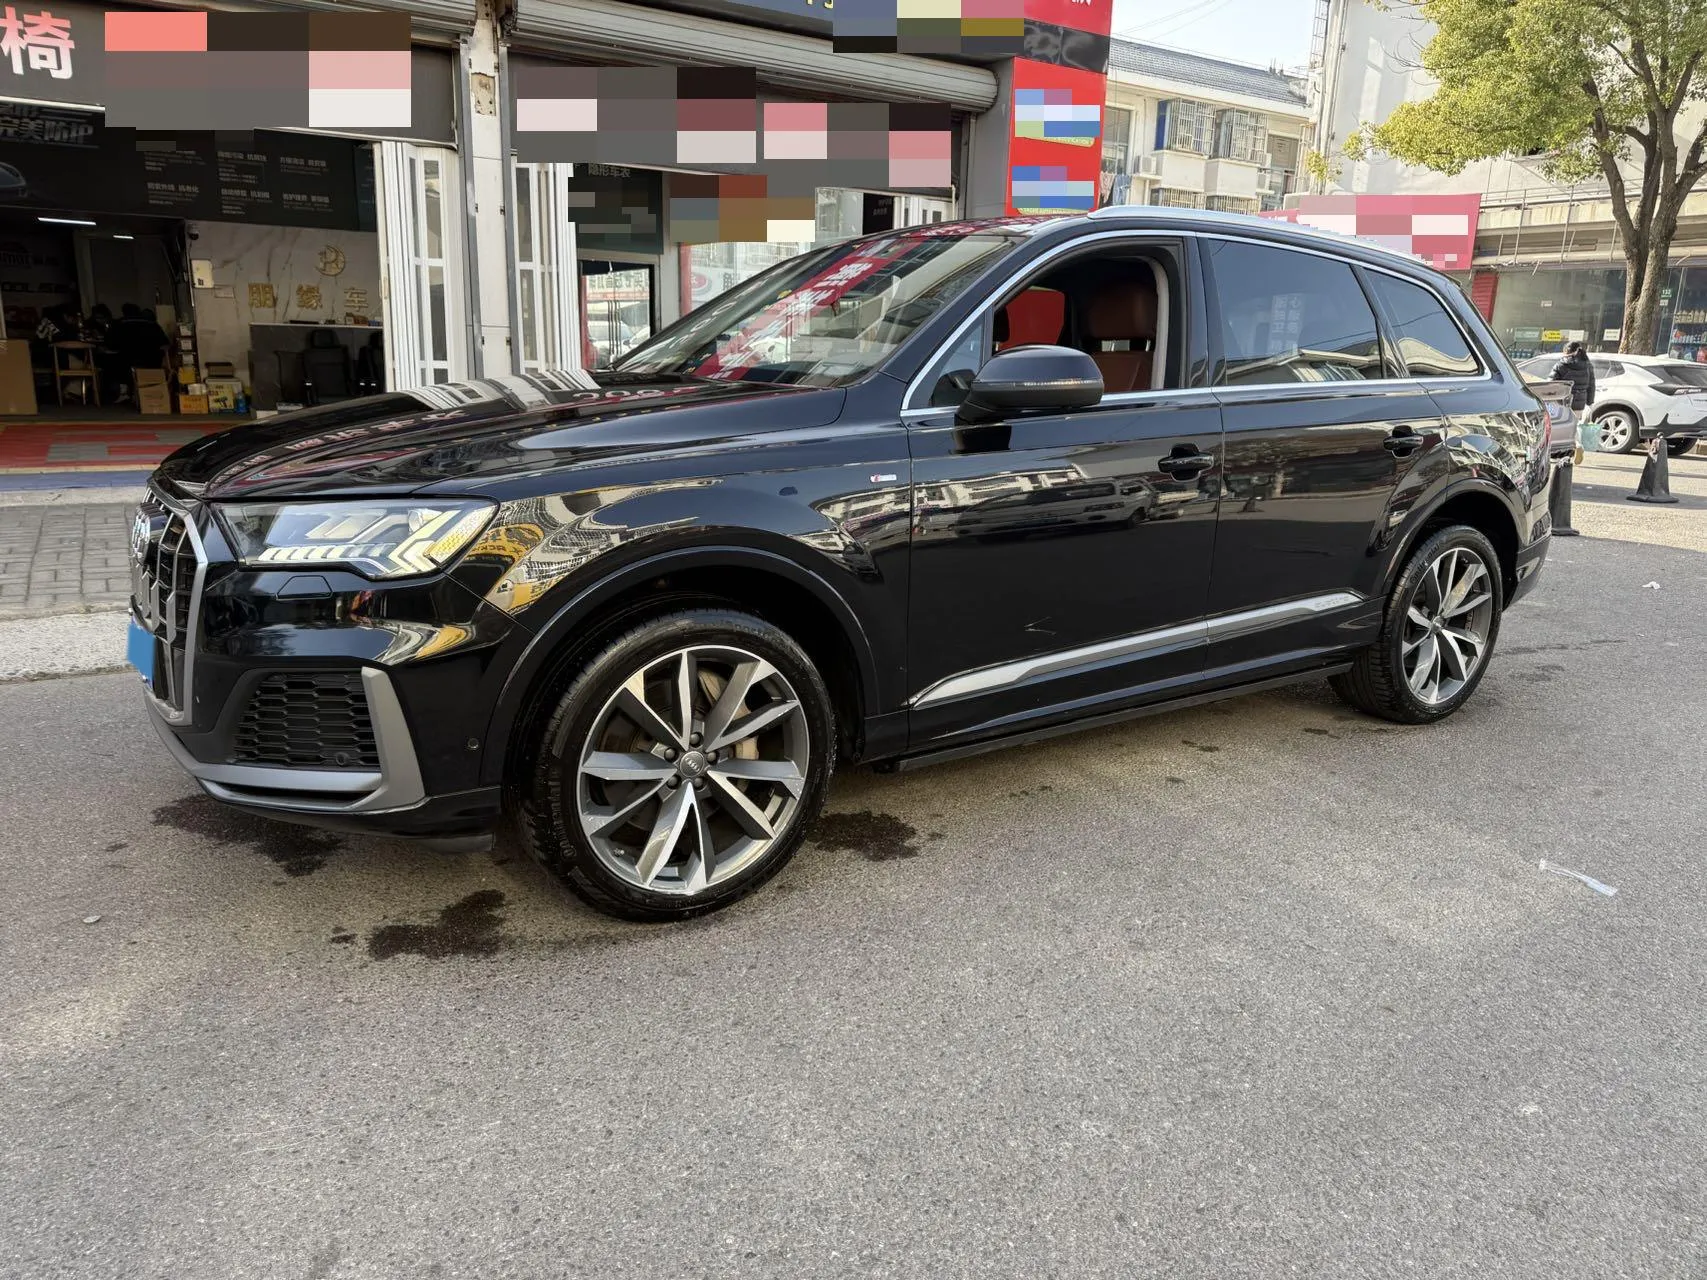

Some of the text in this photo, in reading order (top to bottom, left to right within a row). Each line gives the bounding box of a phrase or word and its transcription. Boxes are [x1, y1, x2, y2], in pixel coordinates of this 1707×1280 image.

[0, 6, 75, 79] 椅
[248, 282, 369, 312] 朋缘车
